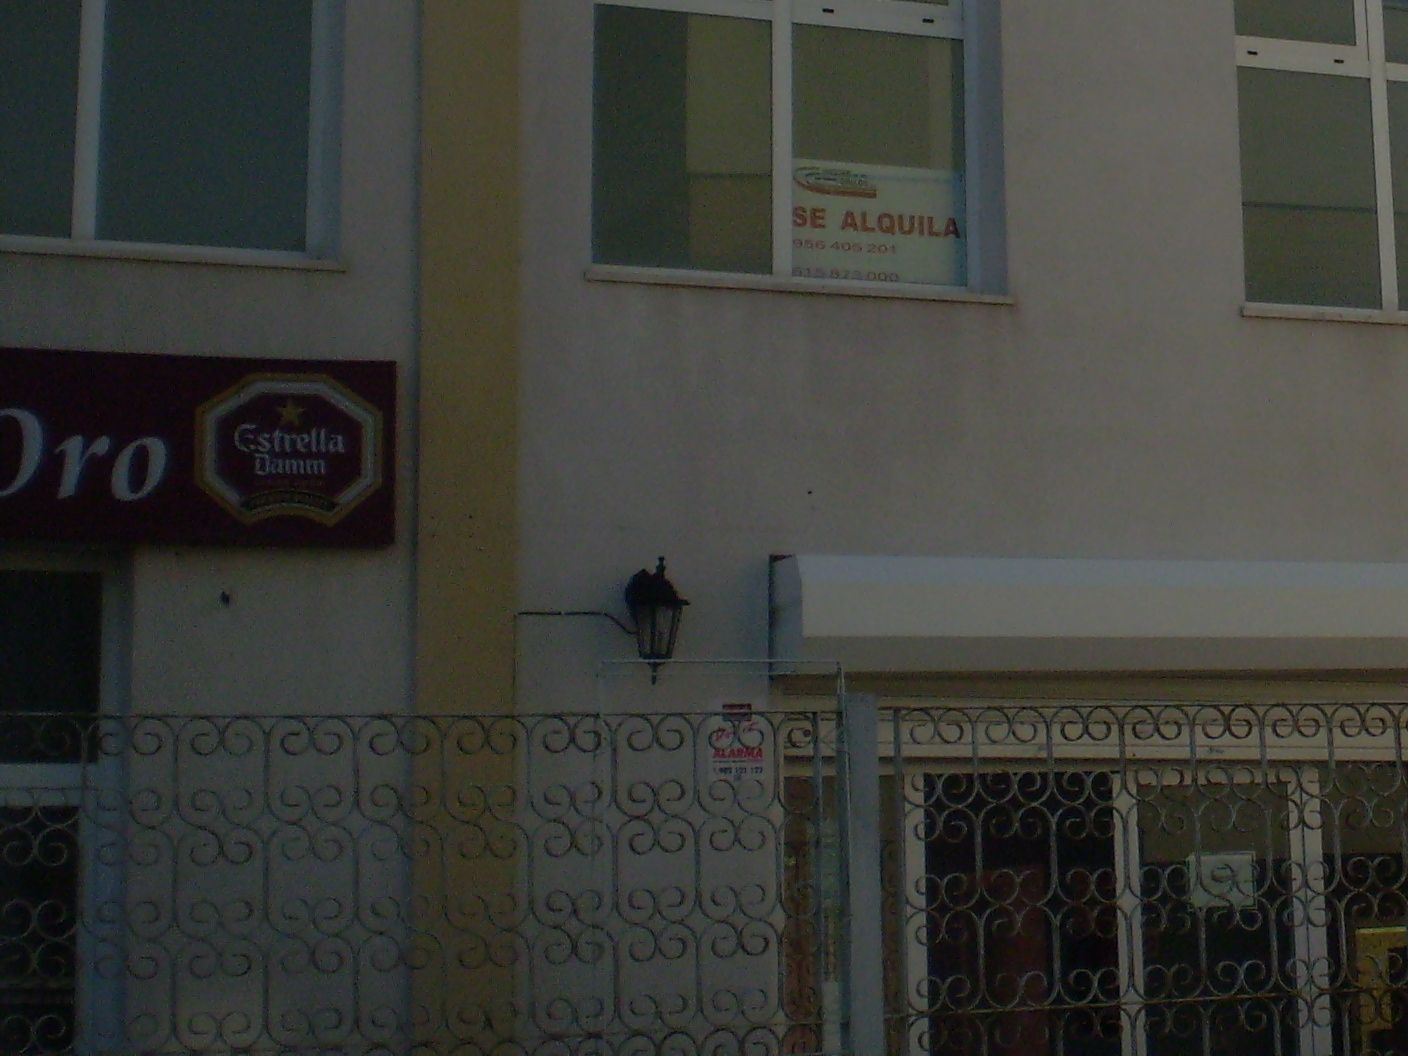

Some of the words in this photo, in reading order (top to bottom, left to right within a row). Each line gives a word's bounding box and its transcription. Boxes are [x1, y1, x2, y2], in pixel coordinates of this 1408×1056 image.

[792, 206, 826, 229] SE
[841, 210, 961, 238] ALQUILA
[793, 239, 826, 251] 956
[234, 423, 346, 454] Estrella
[254, 454, 327, 476] Damm
